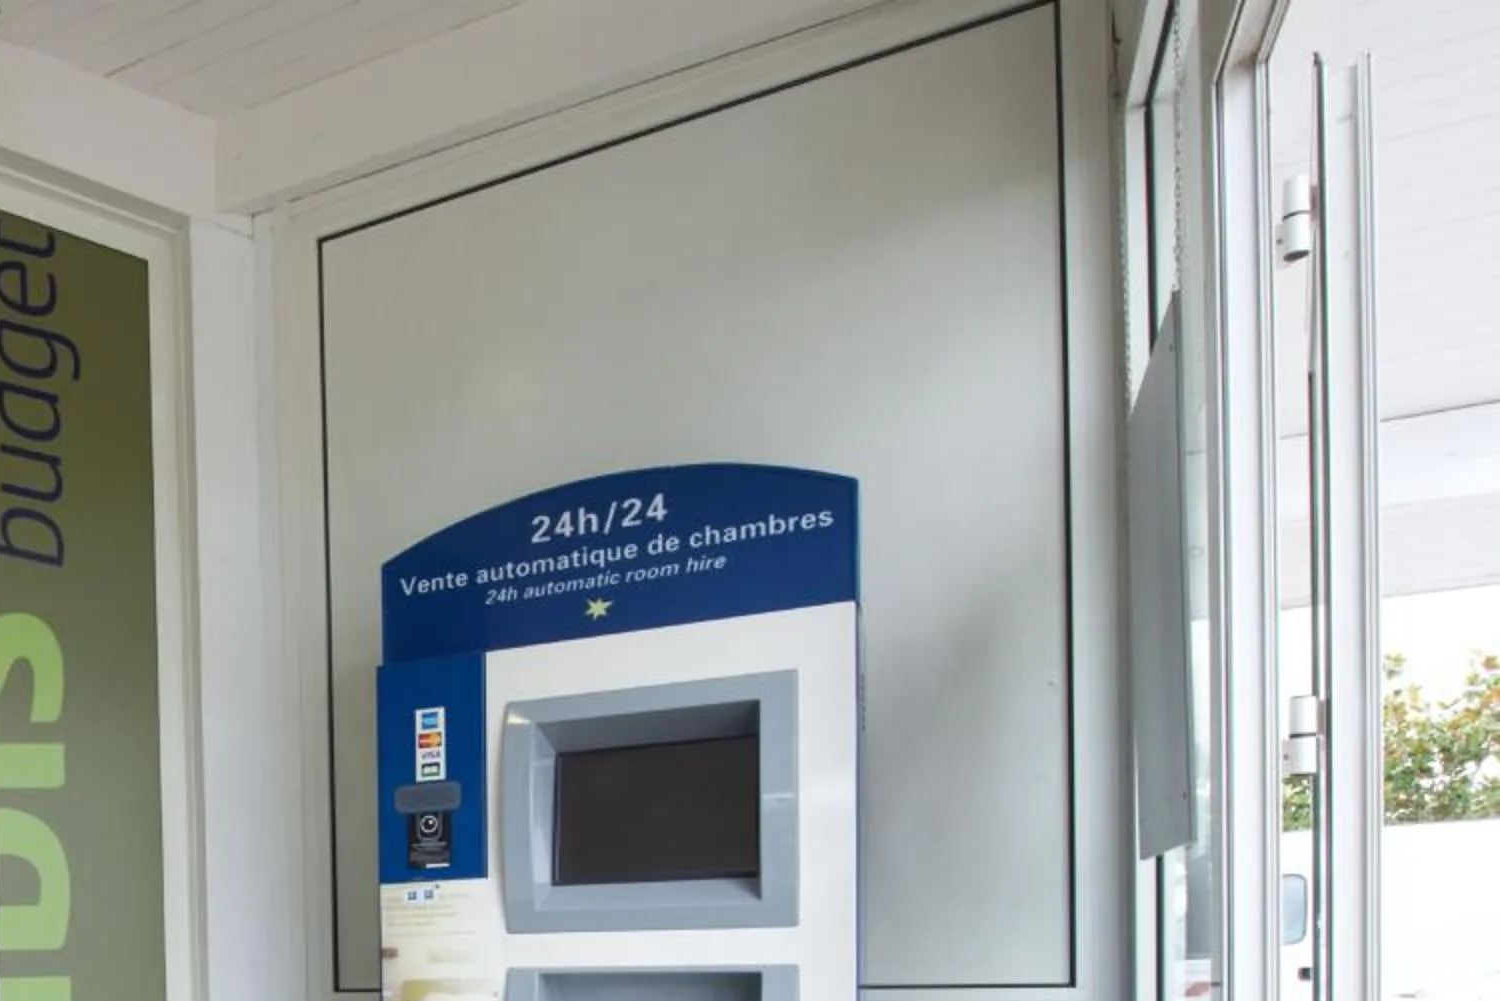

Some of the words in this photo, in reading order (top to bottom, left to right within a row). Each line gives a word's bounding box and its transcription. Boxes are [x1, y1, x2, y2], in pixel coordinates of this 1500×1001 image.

[530, 492, 669, 544] 24h/24
[400, 571, 469, 597] Vente
[476, 542, 639, 585] automatique
[647, 533, 681, 556] de
[688, 509, 835, 549] chambres
[484, 587, 519, 606] 24h
[523, 568, 621, 600] automatic
[625, 562, 681, 584] room
[685, 554, 728, 575] hire
